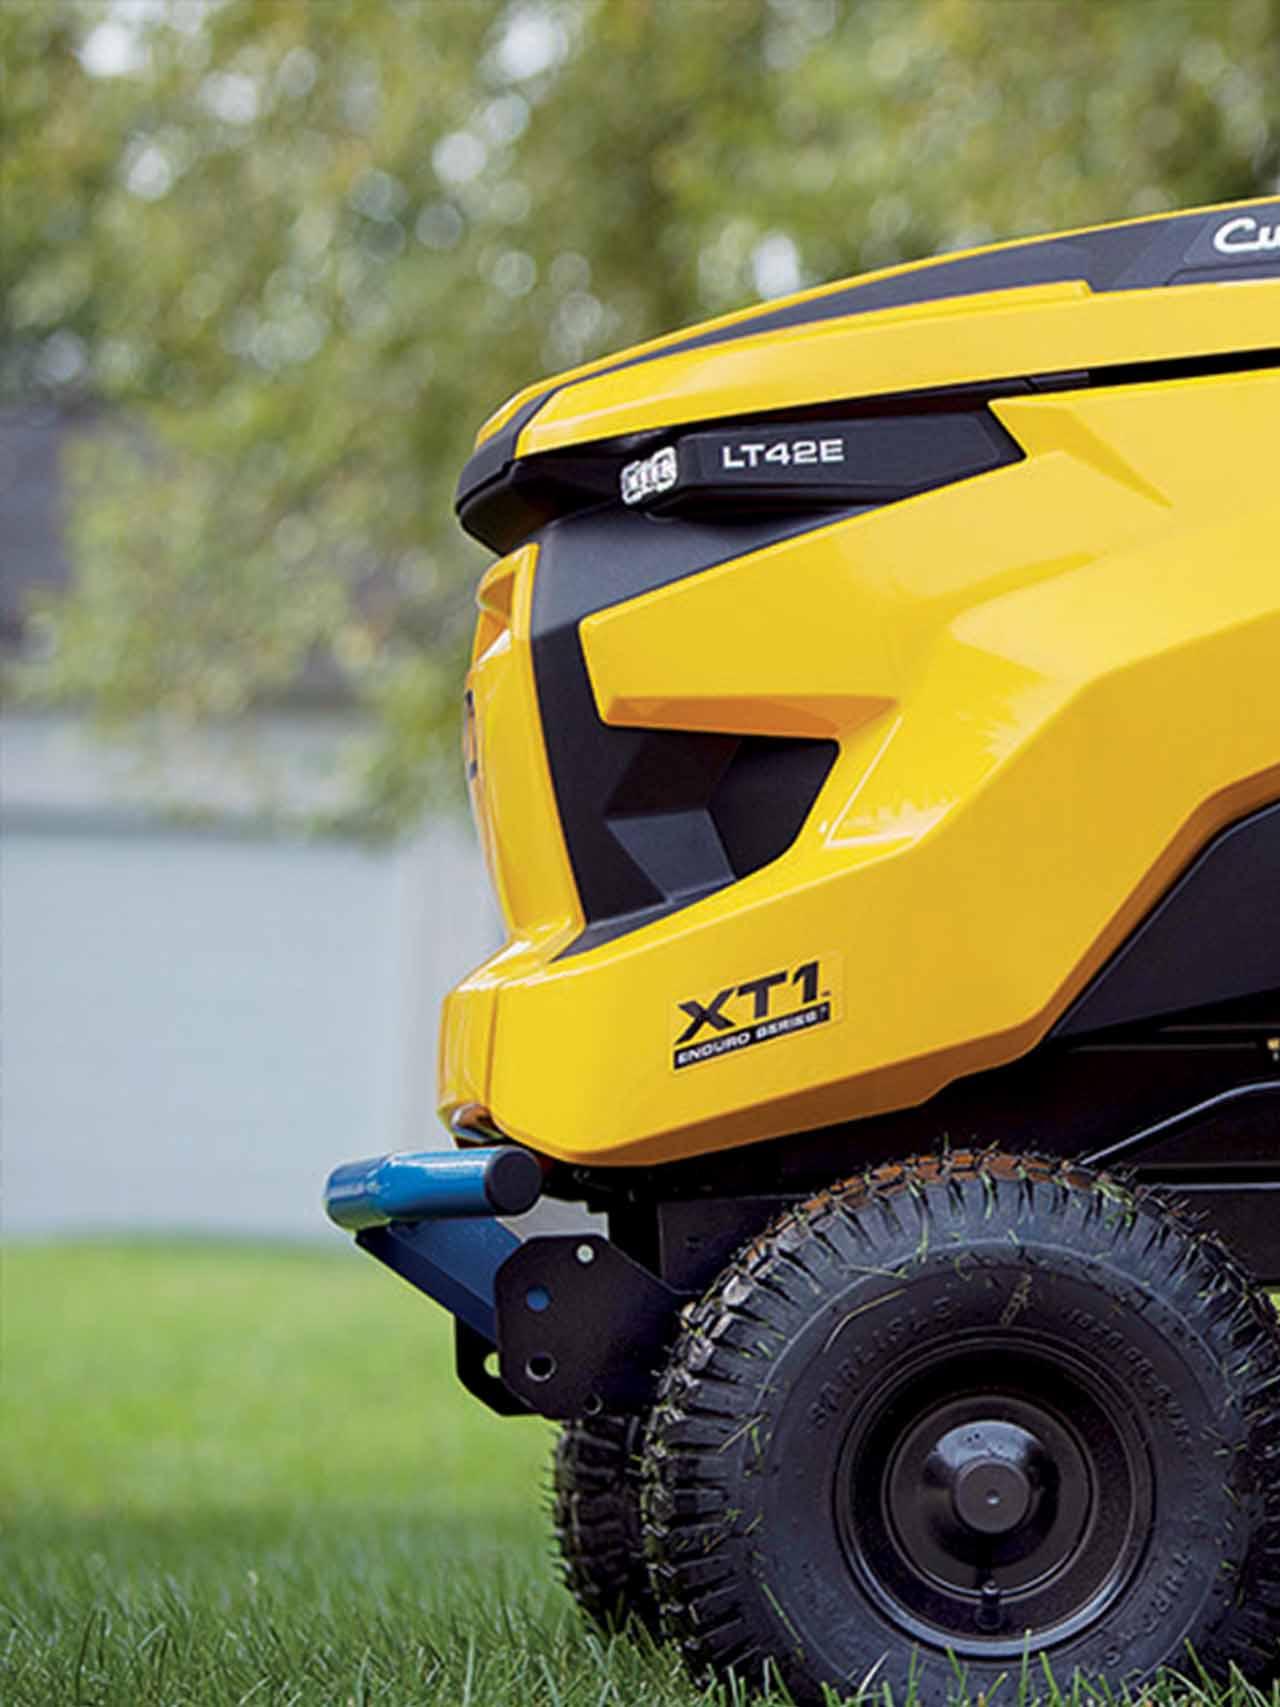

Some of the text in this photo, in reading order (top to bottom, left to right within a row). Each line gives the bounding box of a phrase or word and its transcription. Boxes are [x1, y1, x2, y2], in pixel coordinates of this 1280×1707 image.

[722, 438, 845, 469] LT42E
[674, 960, 819, 1046] XT1
[677, 1011, 818, 1065] ENDURO SERIES
